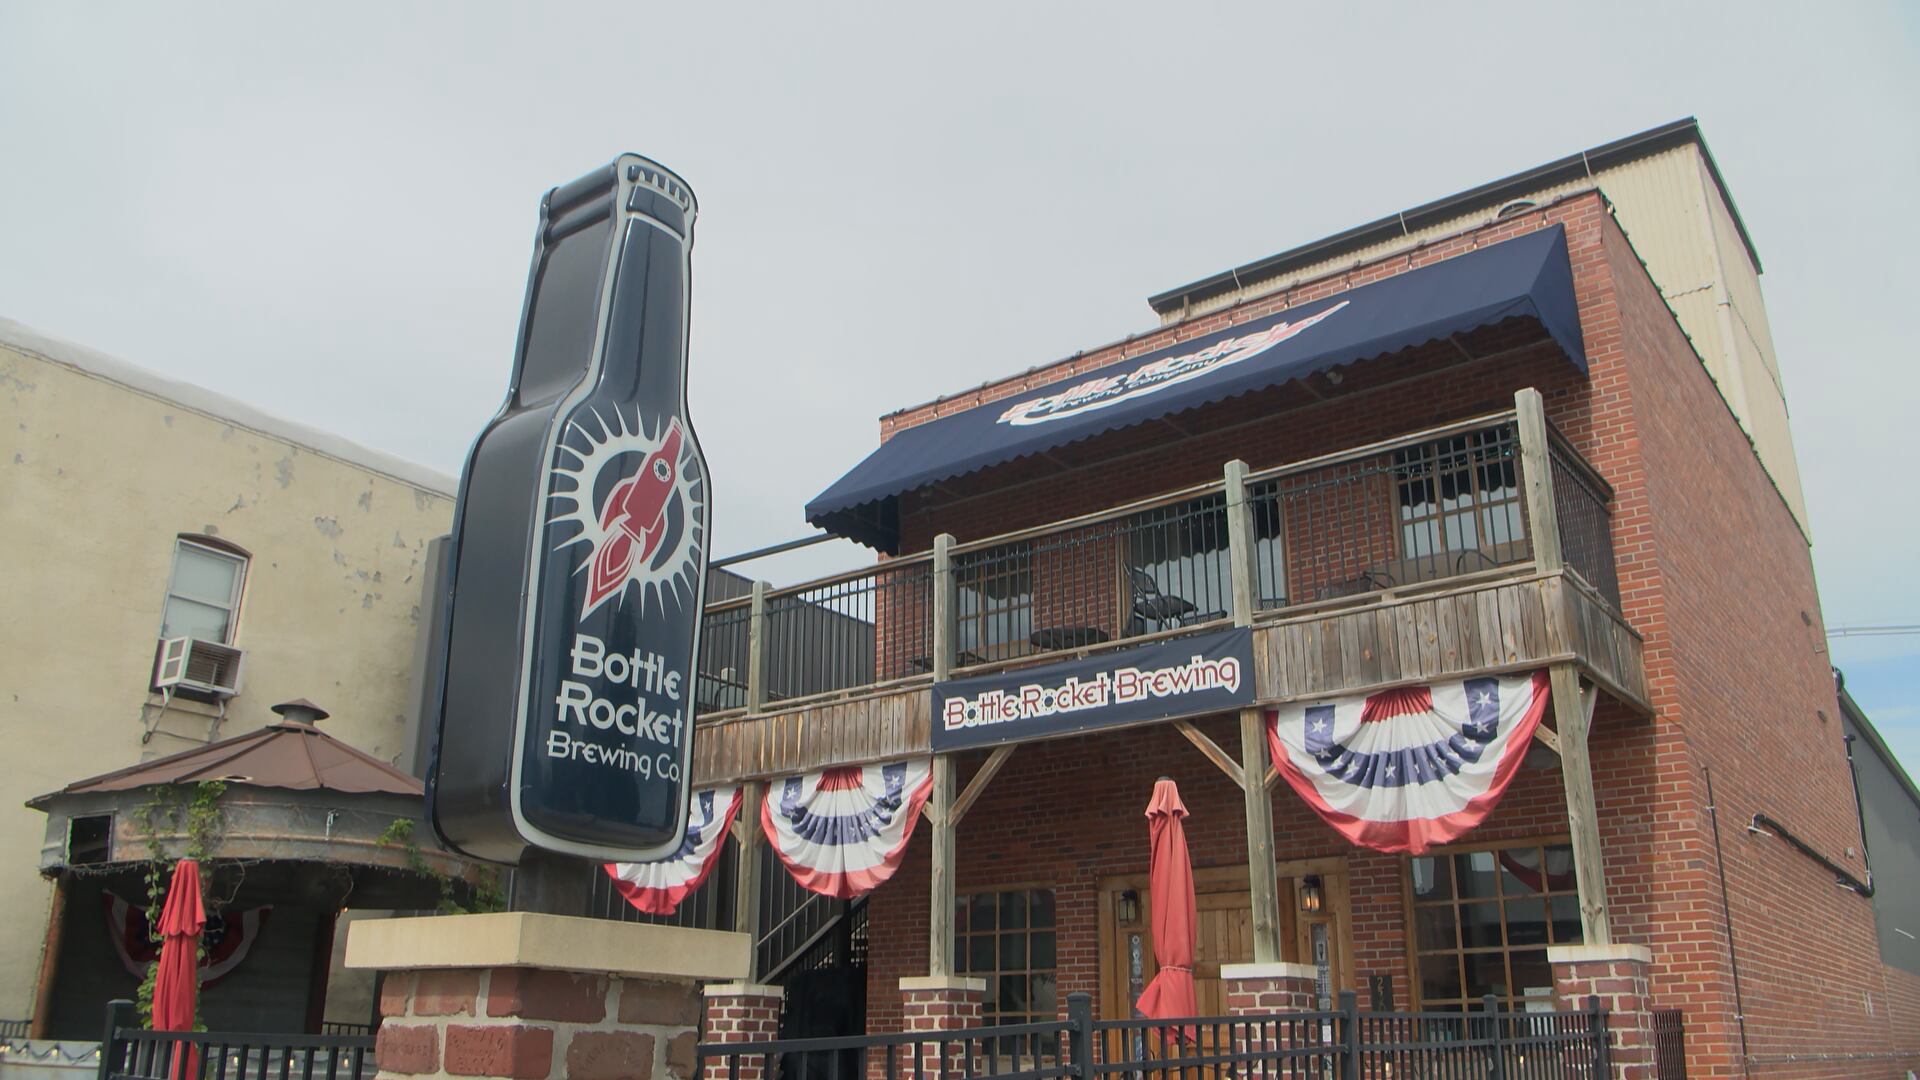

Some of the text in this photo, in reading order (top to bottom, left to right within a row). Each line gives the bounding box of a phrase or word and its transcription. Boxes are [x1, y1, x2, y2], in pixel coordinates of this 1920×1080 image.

[570, 633, 682, 701] Bottle
[945, 656, 1240, 729] Bottle Rocket Brewing
[556, 680, 682, 748] Rocket
[547, 730, 681, 783] Brewing Co.
